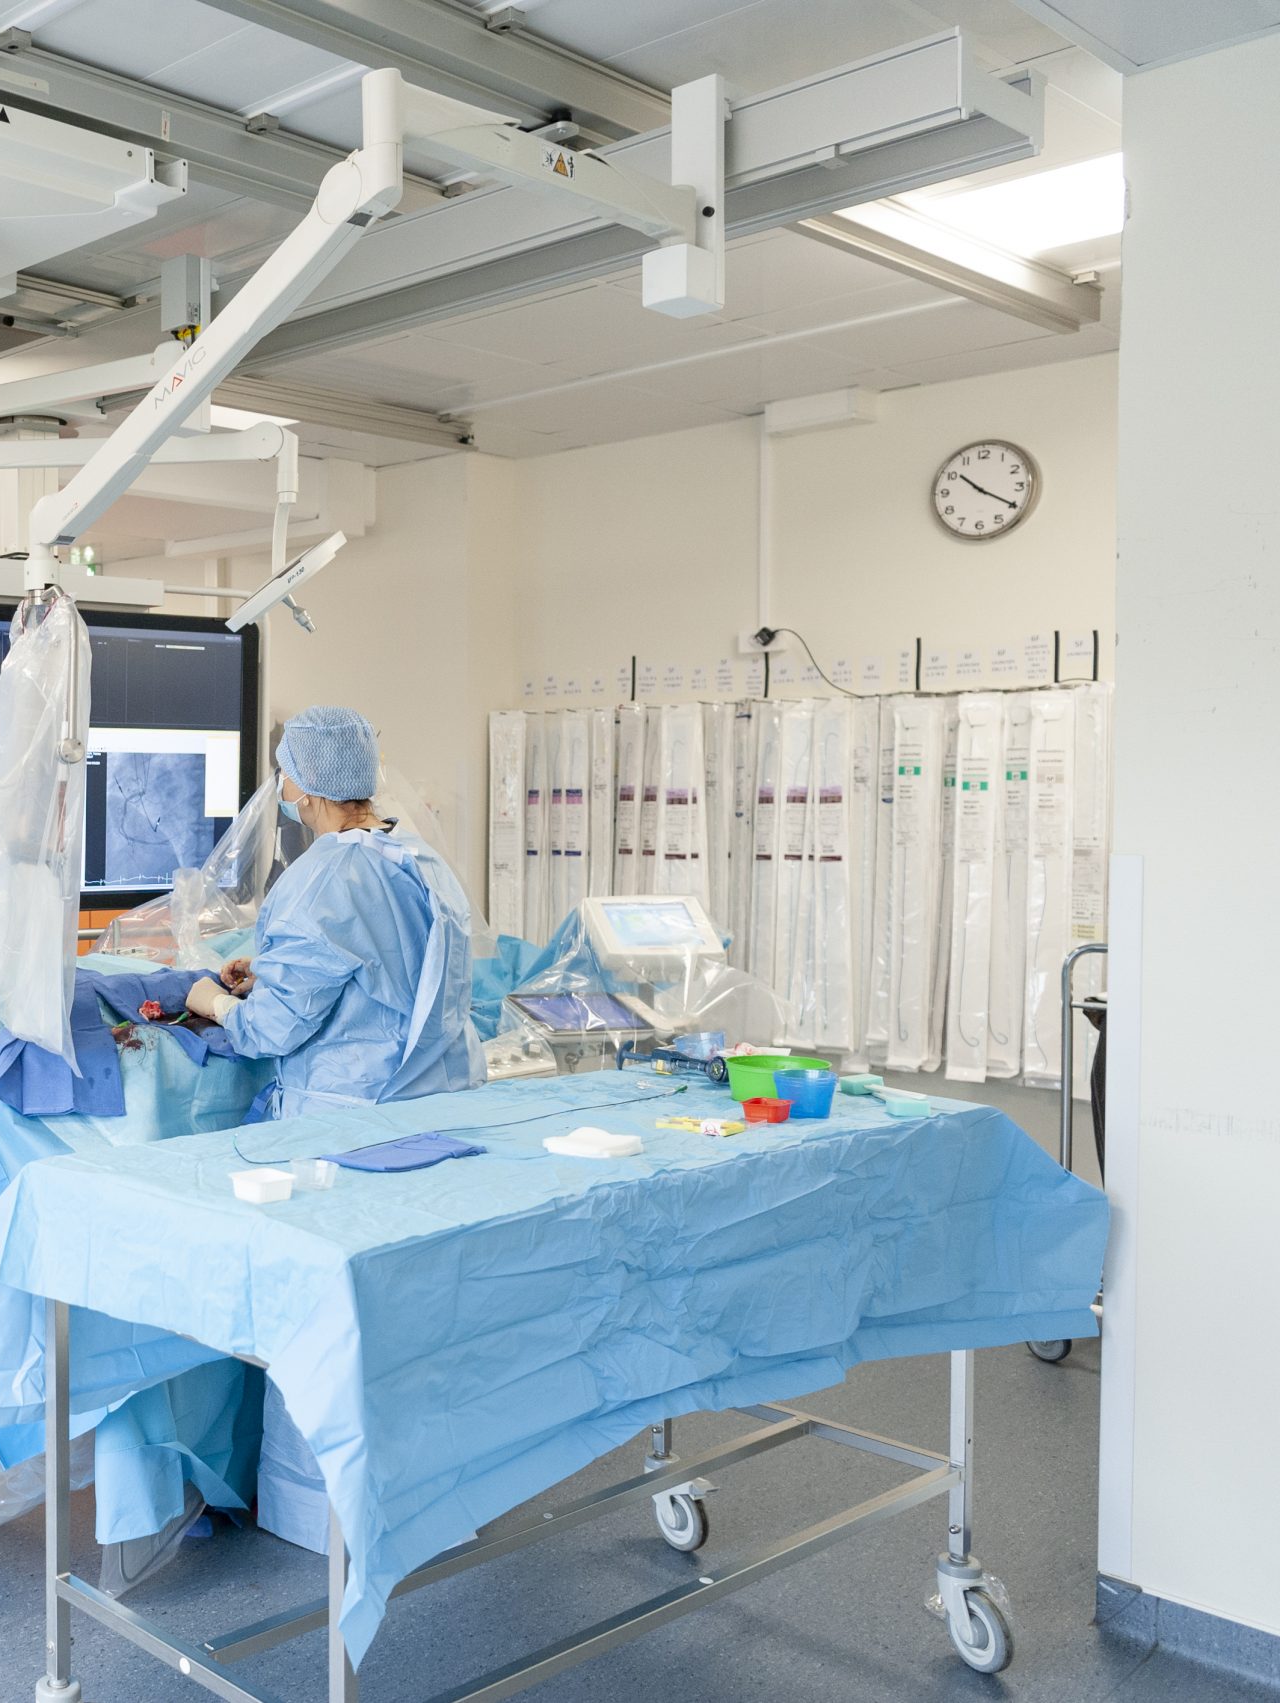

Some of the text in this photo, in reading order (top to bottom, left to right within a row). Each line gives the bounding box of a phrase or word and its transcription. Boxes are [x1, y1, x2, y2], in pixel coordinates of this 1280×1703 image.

[154, 346, 207, 410] MAVIG
[977, 450, 991, 460] 12
[1001, 452, 1004, 462] 1
[962, 456, 970, 466] 11
[1010, 464, 1020, 475] 2
[947, 471, 957, 481] 10
[1014, 482, 1025, 492] 3
[940, 488, 950, 498] 9
[944, 505, 955, 515] 8
[957, 517, 966, 527] 7
[993, 514, 1004, 524] 5
[974, 520, 984, 530] 6
